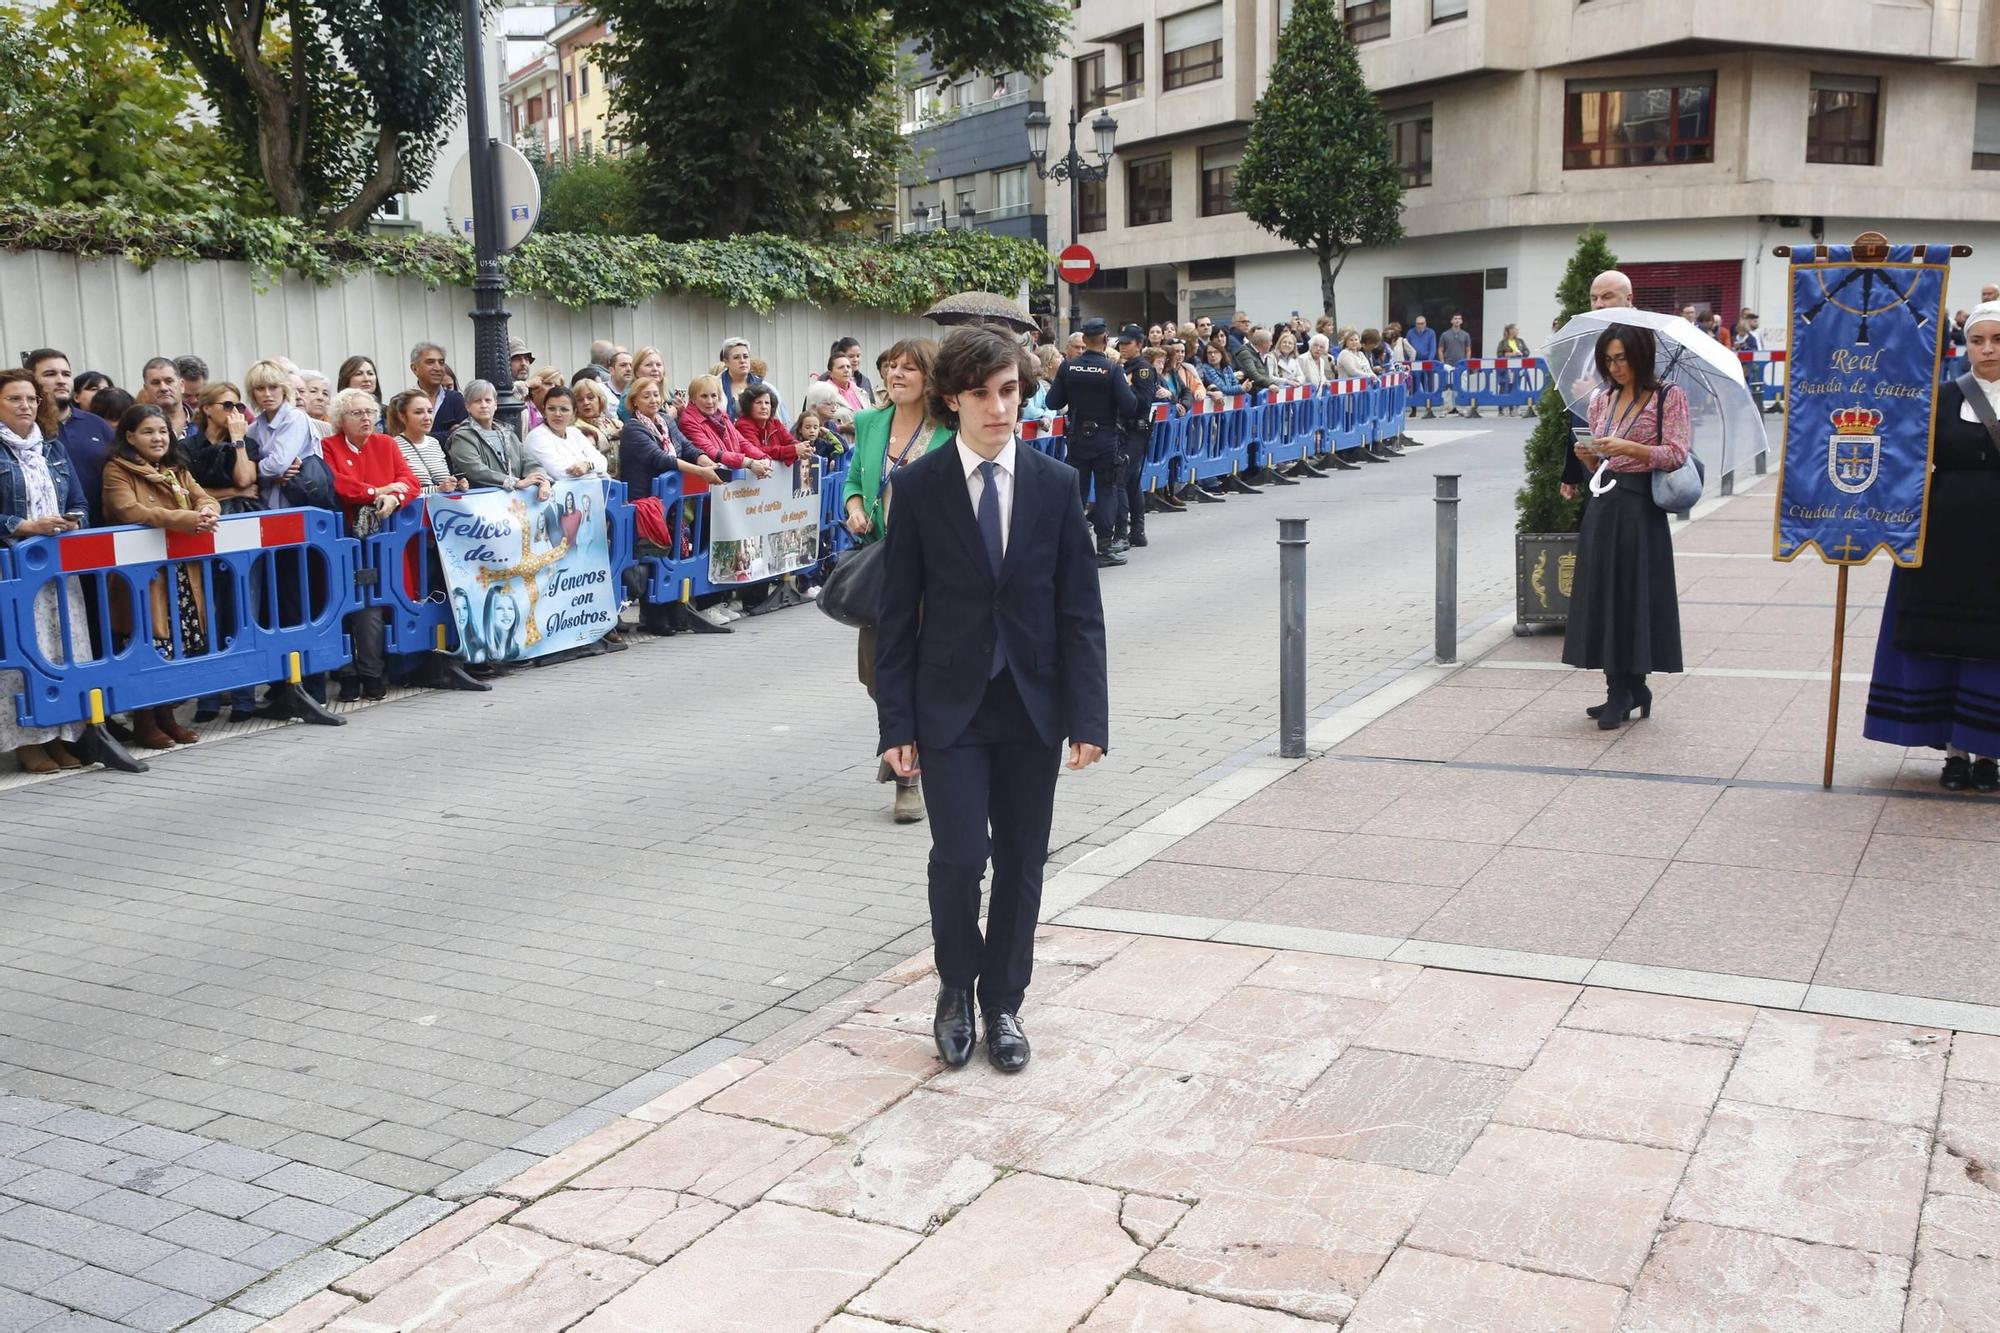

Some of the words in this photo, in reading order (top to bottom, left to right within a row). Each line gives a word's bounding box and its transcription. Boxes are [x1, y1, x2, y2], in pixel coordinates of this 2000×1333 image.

[1069, 365, 1103, 374] POLICIA
[1831, 348, 1885, 373] Real
[1798, 376, 1842, 394] Banda
[1849, 377, 1866, 394] de
[1874, 380, 1925, 400] Gaitas
[1789, 503, 1839, 520] Ciudad
[1843, 504, 1860, 520] de
[1863, 507, 1915, 524] Oviedo
[433, 508, 512, 543] Felices
[463, 544, 509, 563] de...
[571, 592, 594, 608] con
[546, 610, 612, 638] Nosotros.
